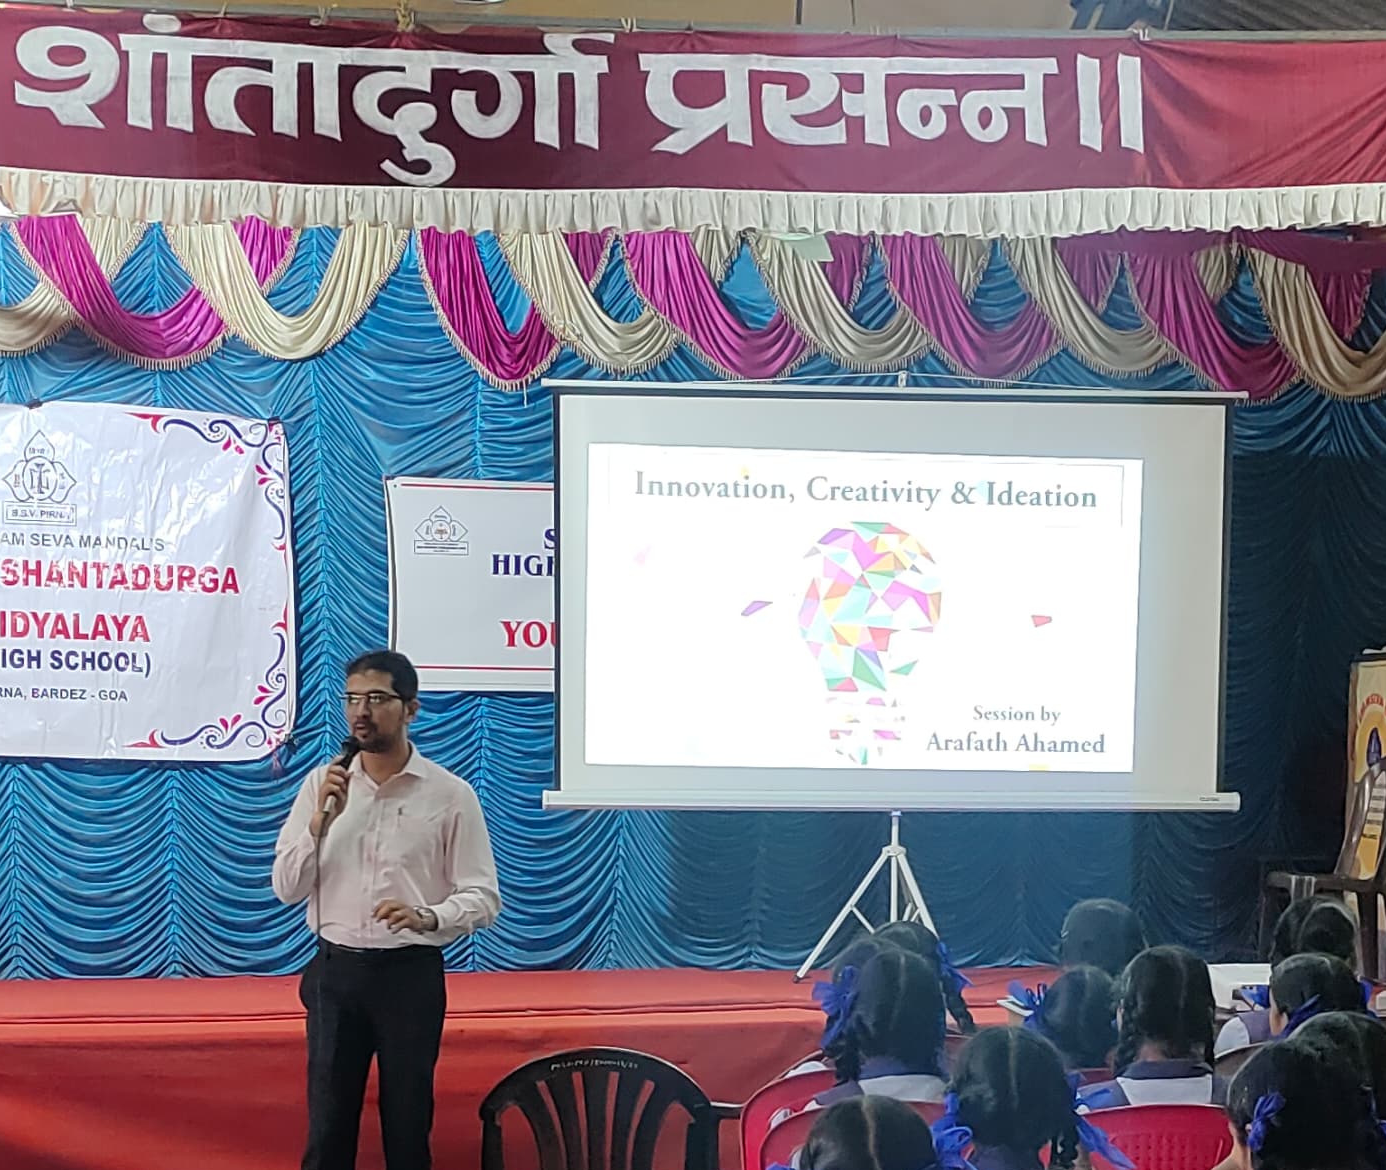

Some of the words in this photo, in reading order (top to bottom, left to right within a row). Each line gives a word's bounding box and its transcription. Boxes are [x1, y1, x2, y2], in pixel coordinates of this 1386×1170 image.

[15, 16, 614, 187] शांतादुर्गा
[635, 470, 795, 503] Innovation,
[807, 475, 941, 511] Creativity
[951, 481, 976, 505] &
[986, 481, 1097, 508] Ideation
[30, 533, 74, 548] SEVA
[79, 535, 164, 551] MANDAL'S
[0, 557, 240, 594] SHANTADURGA
[50, 649, 151, 678] SCHOOL)
[31, 688, 87, 700] BARDEZ
[98, 690, 128, 701] GOA
[973, 705, 1035, 721] Session
[1041, 705, 1061, 726] by
[926, 731, 1008, 752] Arafath
[1015, 732, 1106, 753] Ahamed
